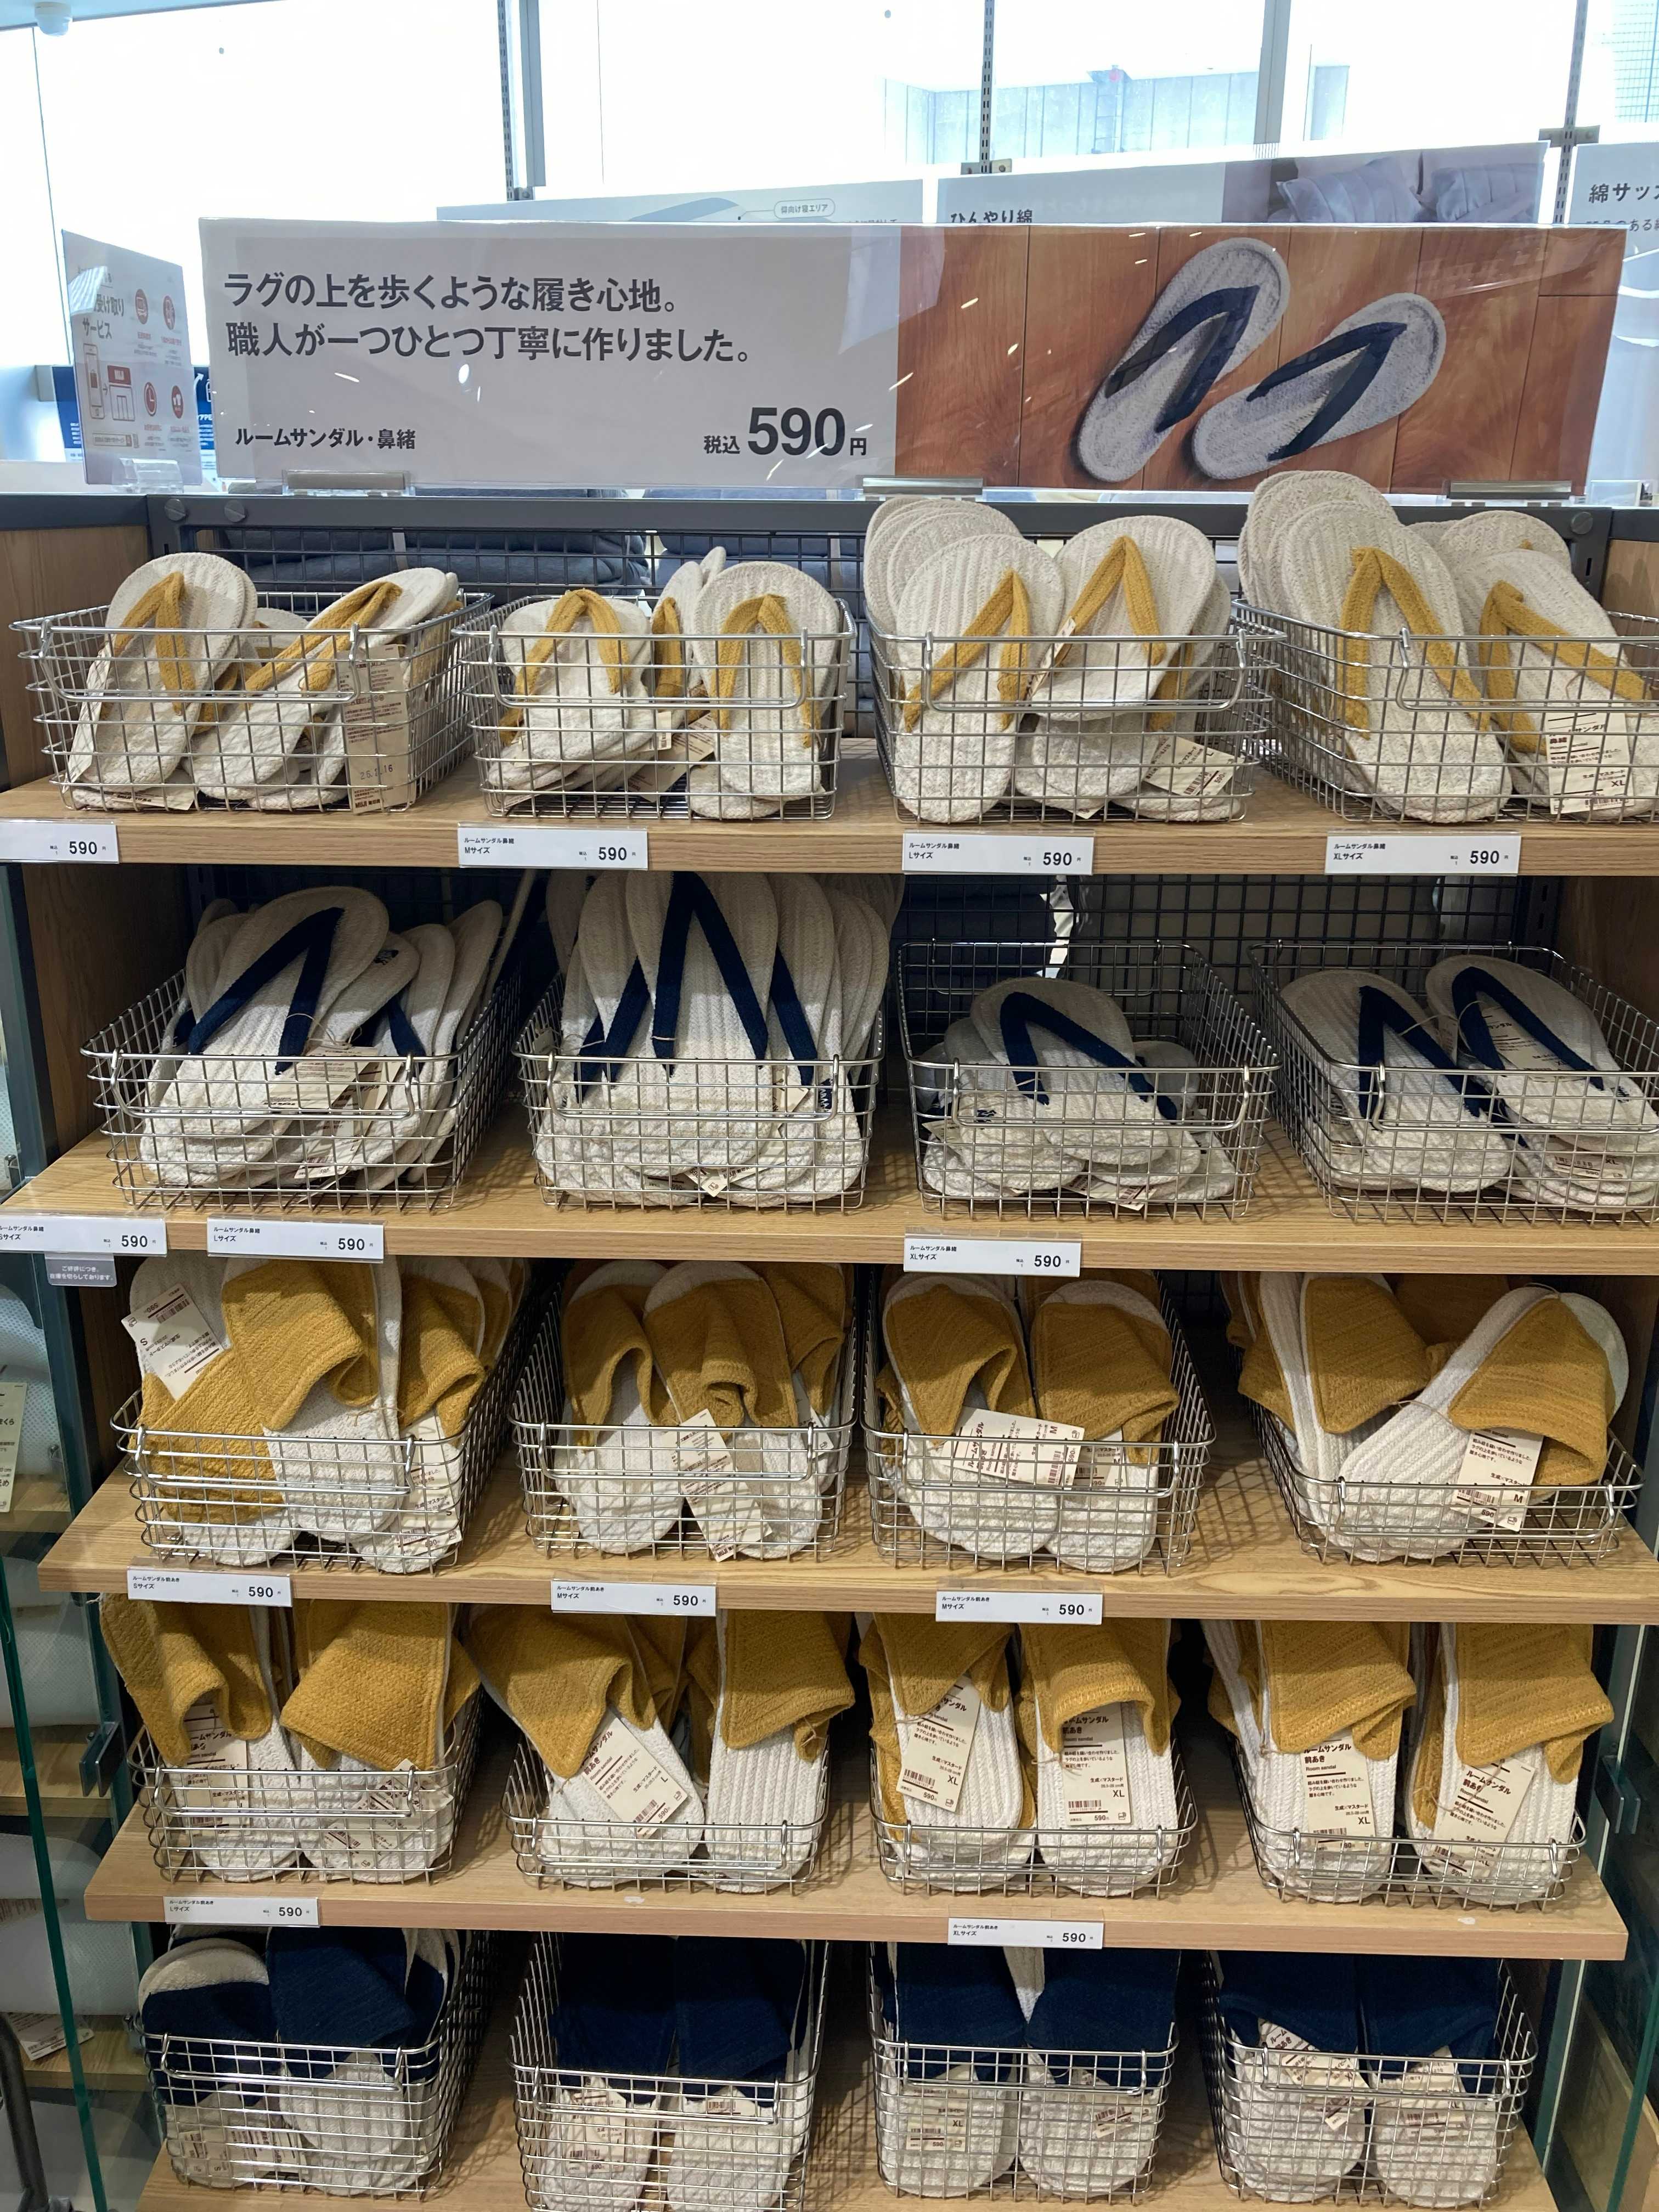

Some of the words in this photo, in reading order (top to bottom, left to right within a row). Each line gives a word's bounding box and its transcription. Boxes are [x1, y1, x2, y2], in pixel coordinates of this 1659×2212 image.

[224, 273, 675, 313] ラグの上を歩くような履き心地。
[82, 317, 112, 339] サービス
[227, 322, 748, 363] 職人が一つひとつ丁寧に作りました。
[703, 435, 741, 455] 税込
[747, 407, 846, 456] 590
[850, 437, 867, 456] 円
[235, 427, 416, 450] ルームサンダル・鼻緒
[69, 841, 97, 855] 590
[598, 847, 627, 861] 590
[1043, 852, 1072, 866] 590
[1470, 850, 1499, 864] 590
[121, 1235, 148, 1248] 590
[338, 1238, 365, 1250] 590
[1034, 1255, 1061, 1267] 590
[140, 1338, 148, 1346] S
[1049, 1425, 1058, 1435] M
[1514, 1494, 1523, 1503] M
[1481, 1509, 1494, 1518] 590
[248, 1587, 274, 1598] 590
[673, 1595, 698, 1606] 590
[1059, 1604, 1085, 1615] 590
[941, 1697, 967, 1712] サンダル
[190, 1731, 232, 1741] ームサンダル
[1304, 1743, 1352, 1754] ルームサンダル
[1305, 1756, 1325, 1764] 前あき
[947, 1775, 959, 1786] XL
[1358, 1816, 1371, 1825] XL
[279, 1907, 302, 1917] 590
[1062, 1933, 1086, 1943] 590
[952, 2119, 963, 2128] XL
